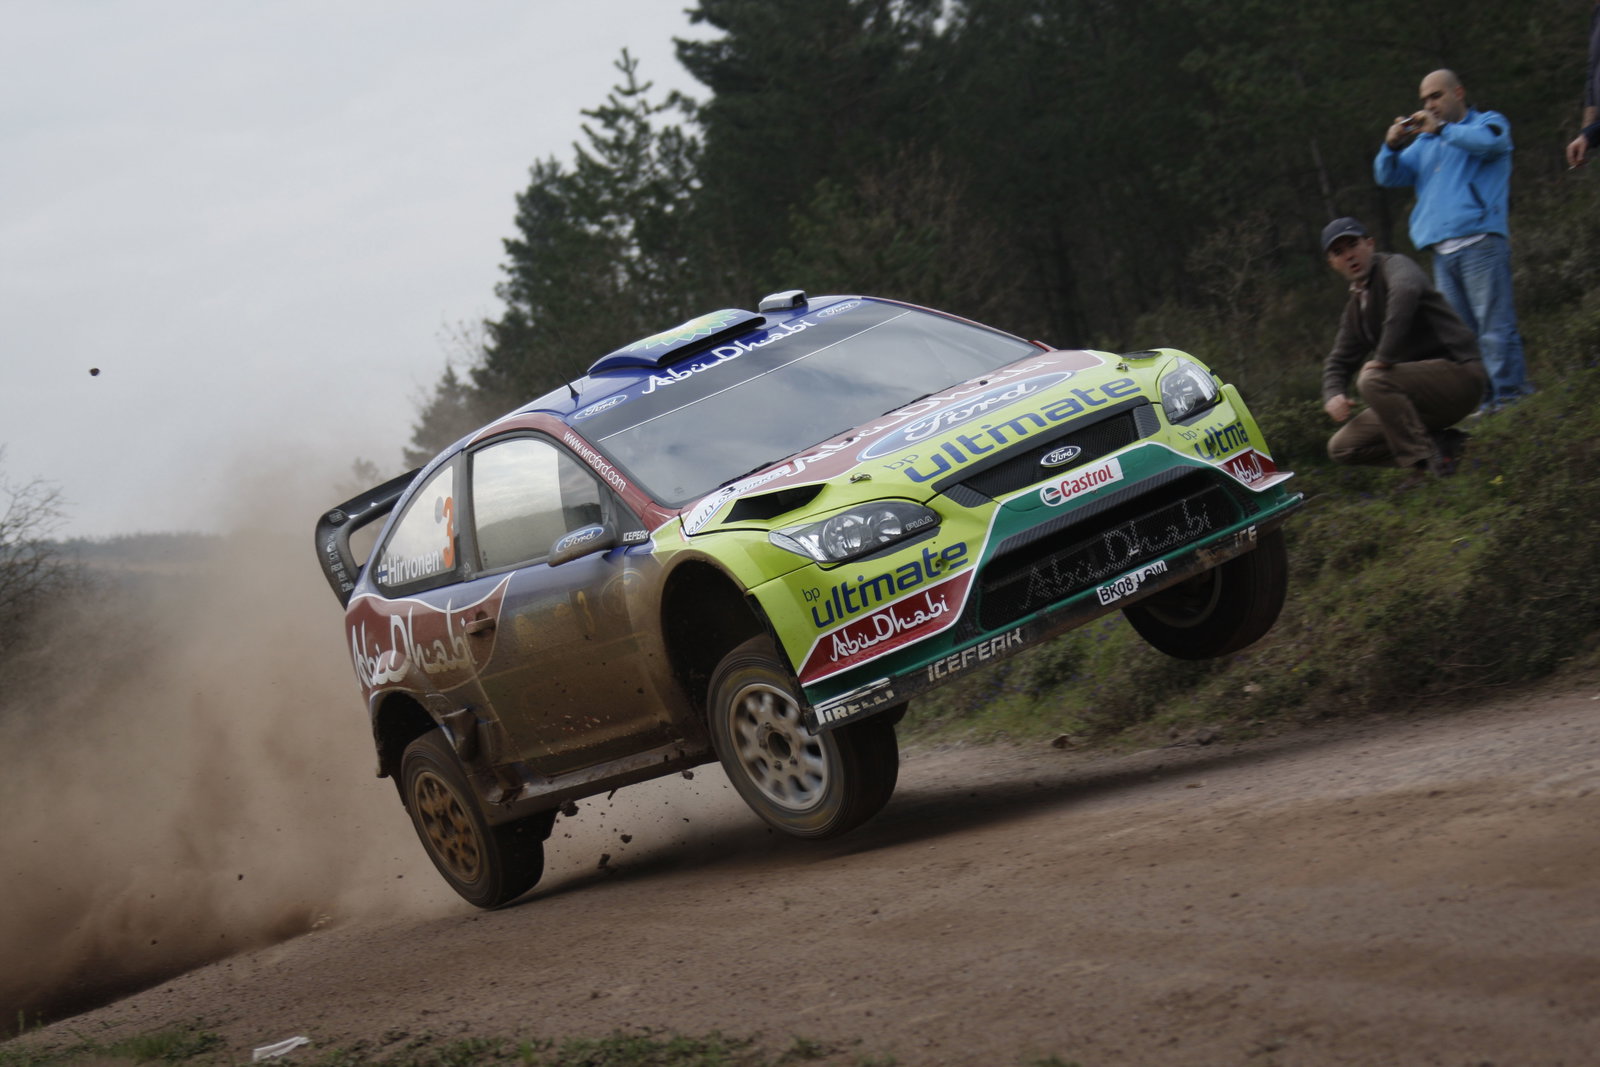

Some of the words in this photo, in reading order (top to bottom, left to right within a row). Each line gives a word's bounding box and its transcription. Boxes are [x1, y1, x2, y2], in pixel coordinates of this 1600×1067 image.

[584, 398, 618, 416] Ford
[904, 382, 1039, 442] Ford
[903, 377, 1142, 483] ultimate
[1178, 430, 1197, 441] bp
[563, 431, 626, 492] www.wrcford.com
[883, 454, 919, 471] bp
[1051, 447, 1074, 463] Ford
[1060, 464, 1114, 498] Castrol
[442, 496, 454, 569] 3
[688, 503, 715, 536] RALLY
[906, 515, 935, 531] PIAA
[564, 529, 595, 549] Ford
[388, 548, 440, 585] Hirvonen
[802, 586, 821, 602] bp
[811, 541, 969, 629] ultimate
[1100, 579, 1135, 602] BK08
